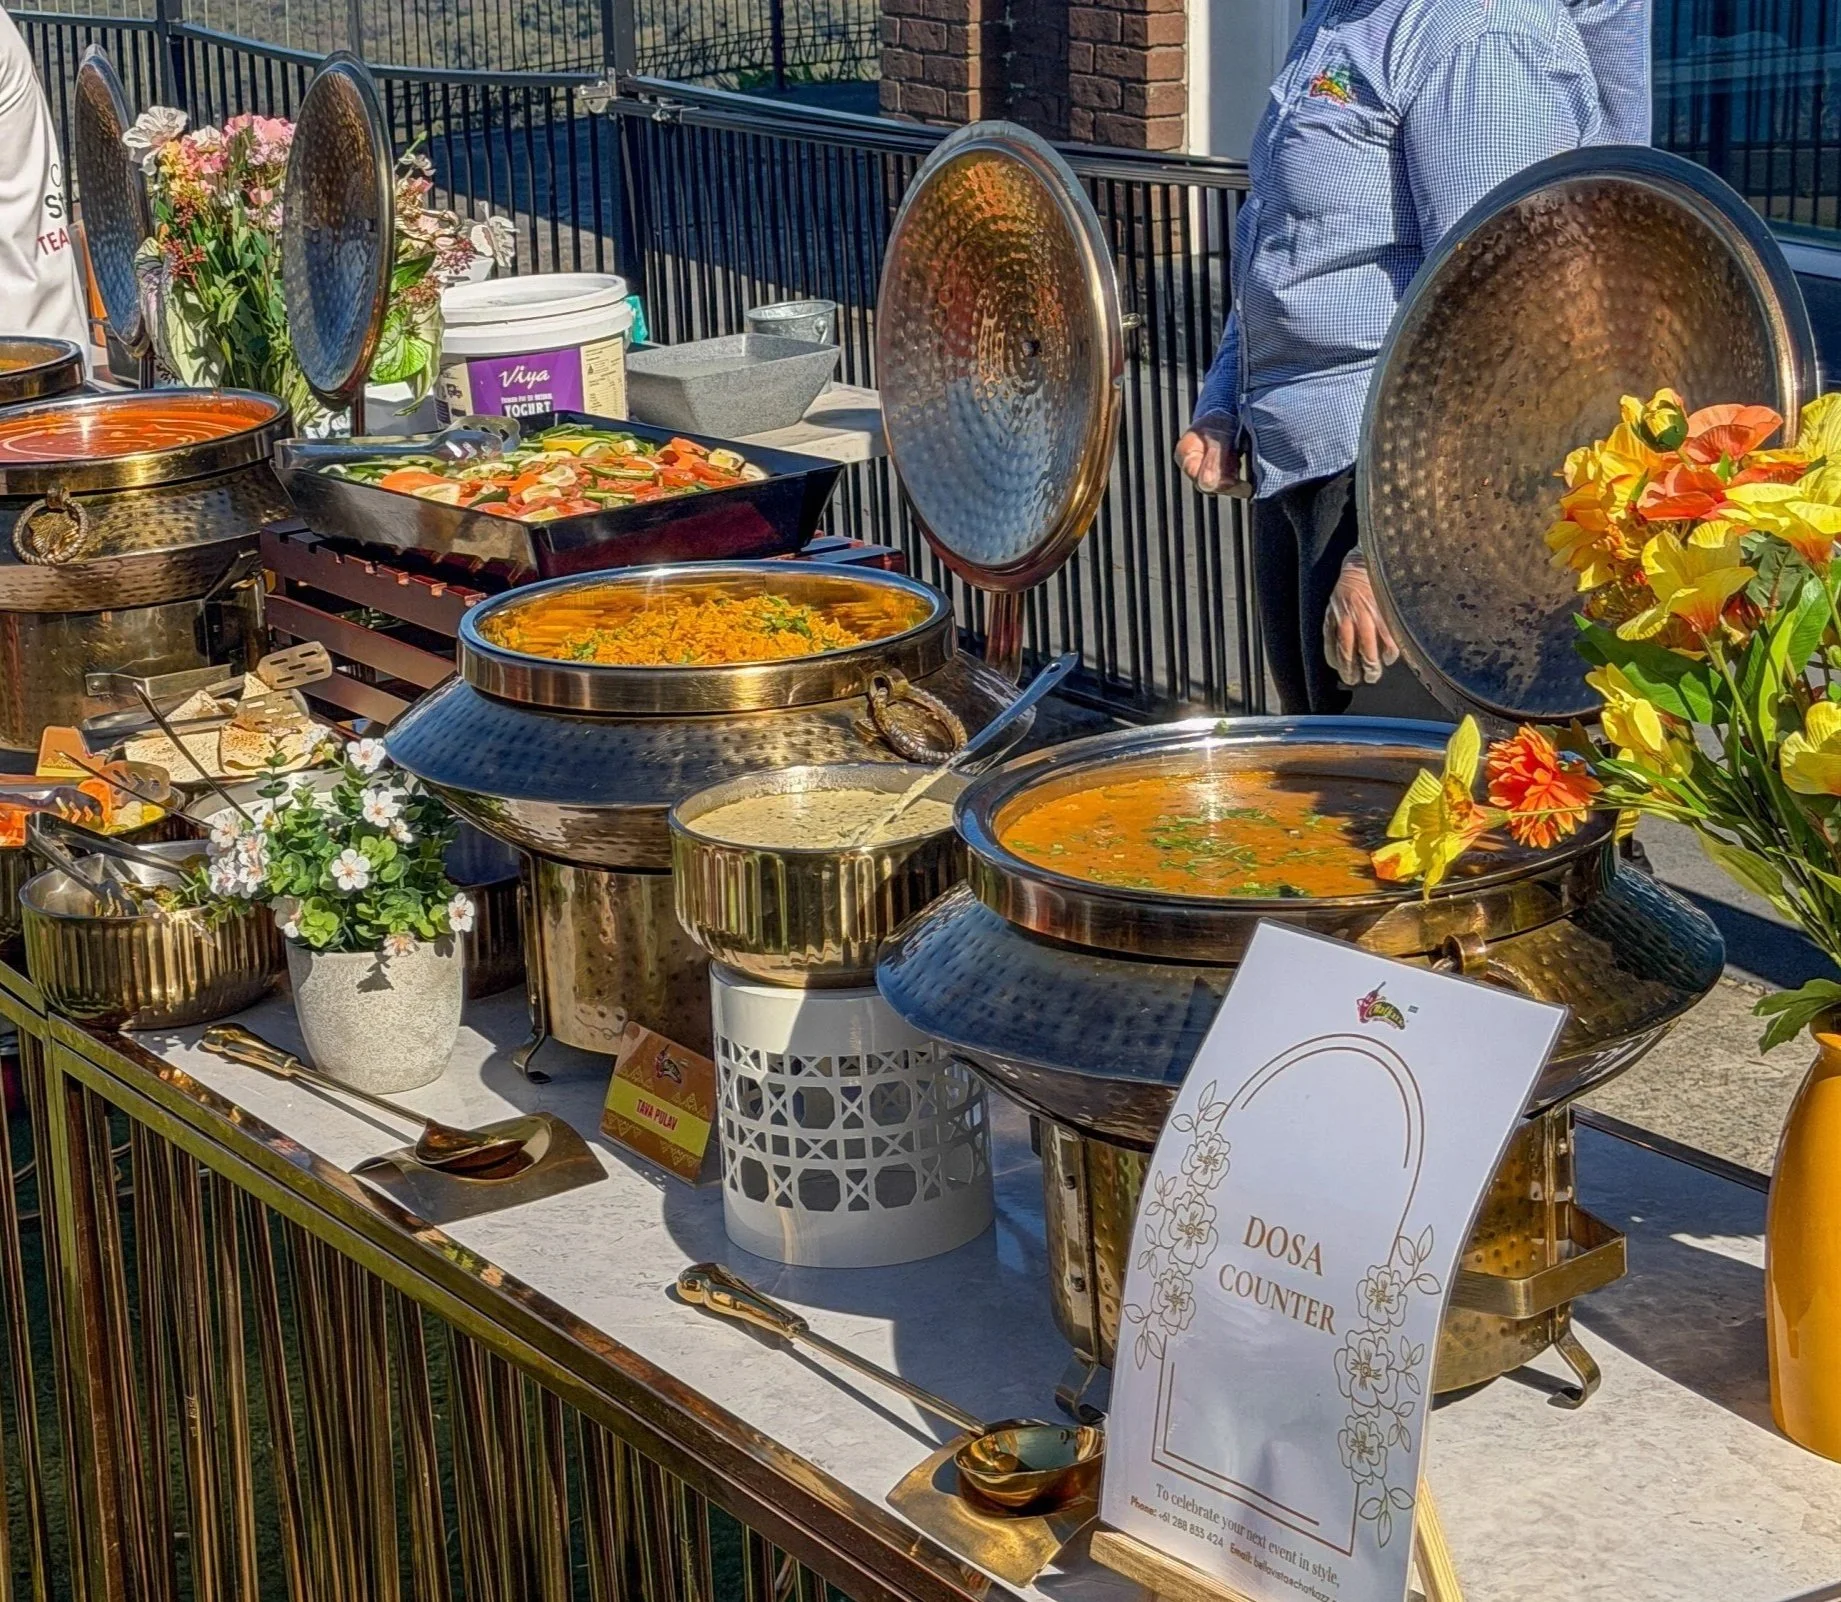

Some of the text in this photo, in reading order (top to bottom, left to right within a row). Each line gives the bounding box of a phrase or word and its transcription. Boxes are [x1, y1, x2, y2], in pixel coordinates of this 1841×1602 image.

[498, 365, 550, 390] Viya
[636, 1099, 654, 1119] TAVA
[1242, 1215, 1323, 1277] DOSA
[1219, 1263, 1336, 1336] COUNTER
[1130, 1495, 1158, 1517] Phone:
[1206, 1532, 1224, 1548] 424
[1229, 1542, 1253, 1565] Email:
[1156, 1483, 1341, 1589] To celebrate your next event in style,
